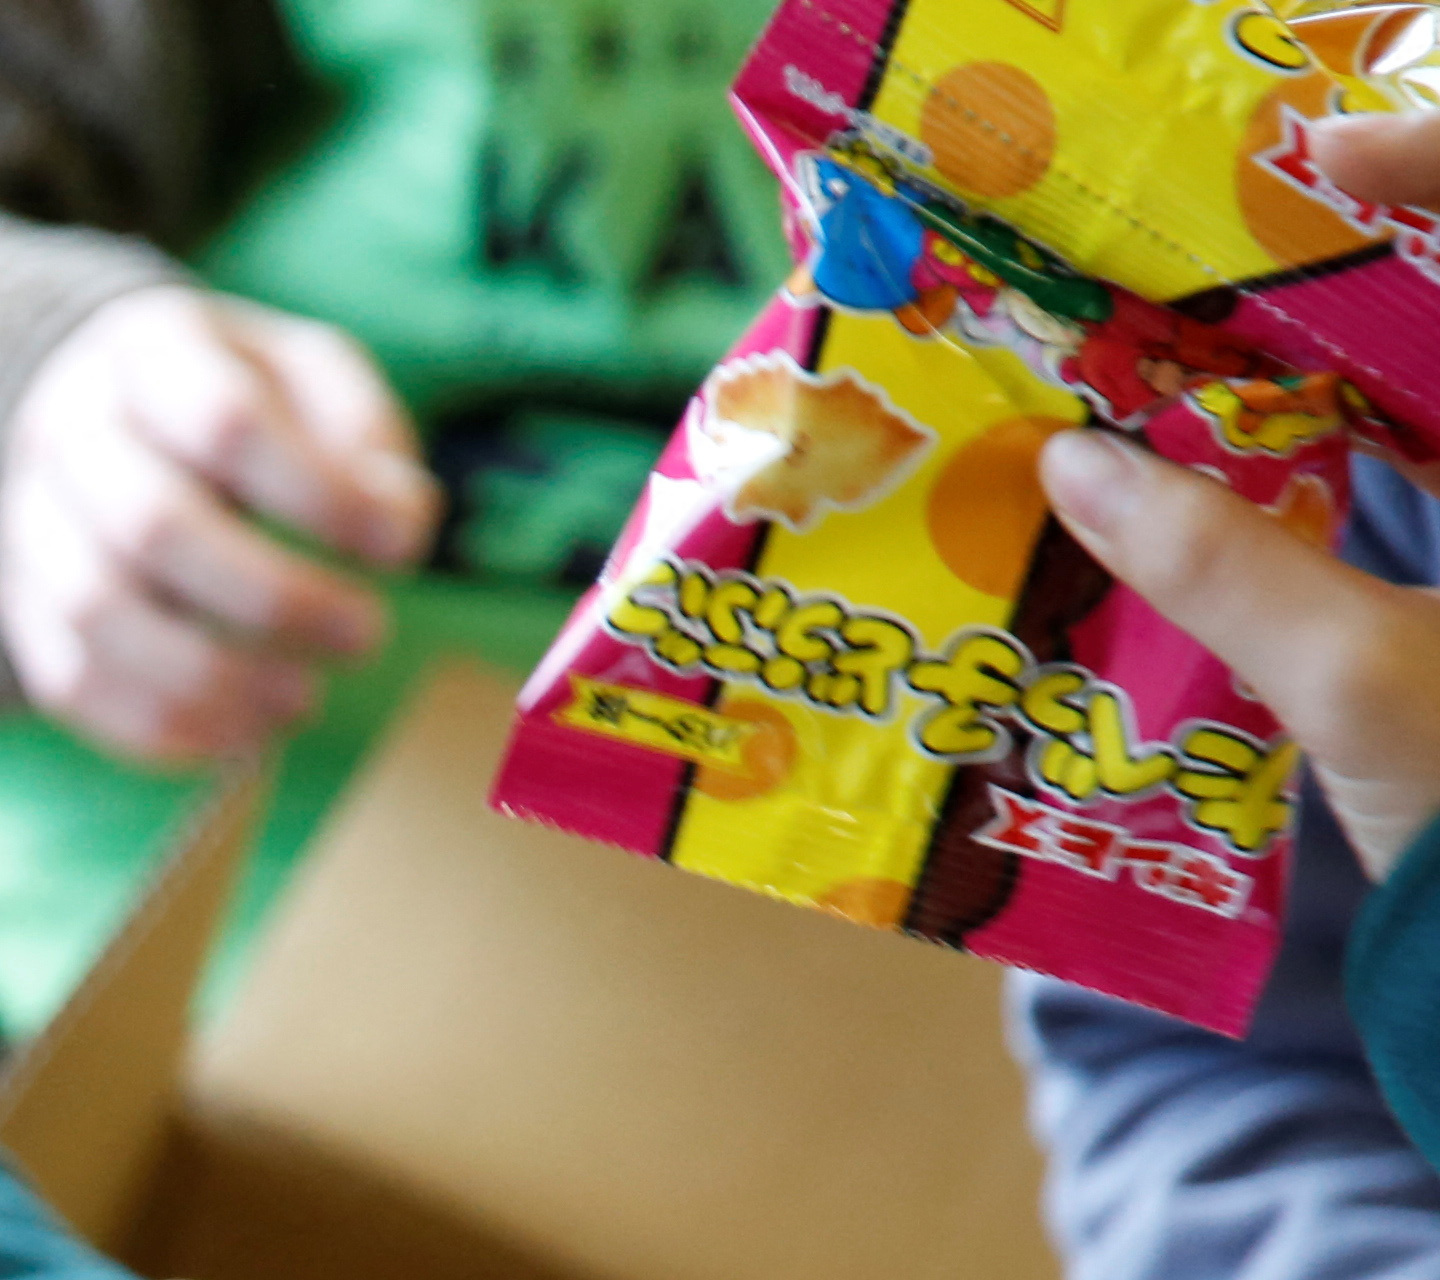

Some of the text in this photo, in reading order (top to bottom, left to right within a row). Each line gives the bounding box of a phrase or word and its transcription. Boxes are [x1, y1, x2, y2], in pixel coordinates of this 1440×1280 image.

[602, 555, 1296, 854] たべっ子どうぶつ
